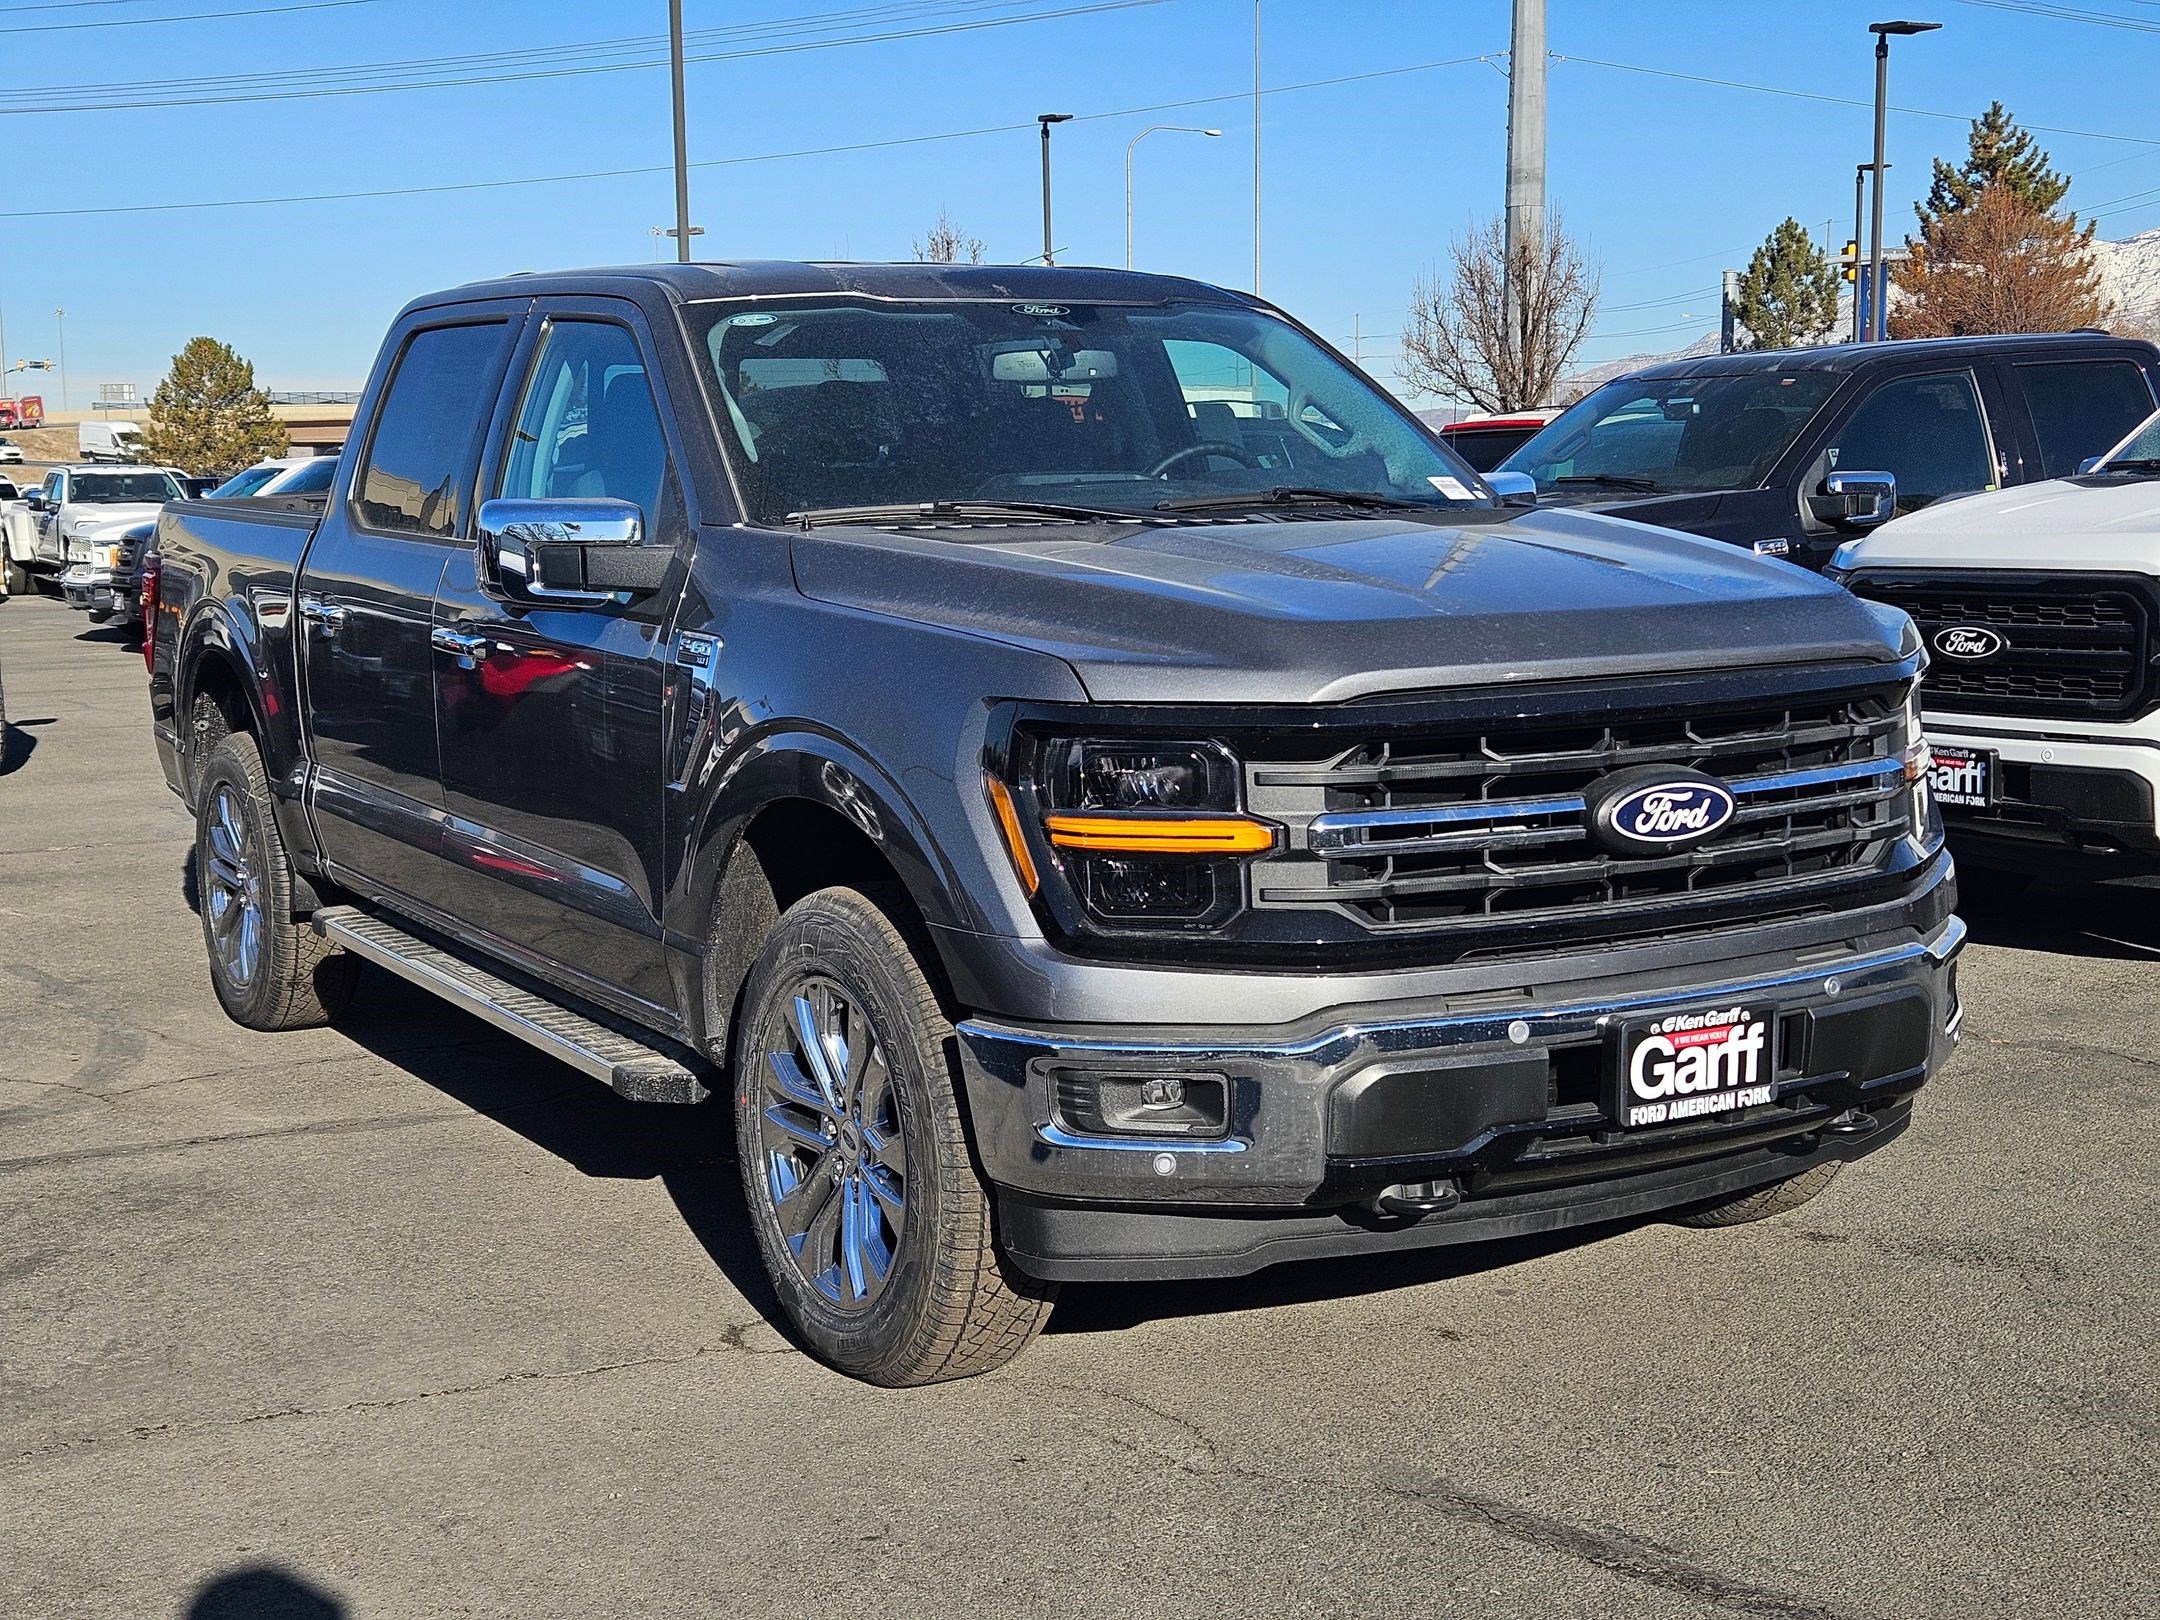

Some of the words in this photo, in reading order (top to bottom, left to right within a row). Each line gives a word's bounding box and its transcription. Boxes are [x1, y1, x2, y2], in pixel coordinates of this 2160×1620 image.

[1024, 304, 1060, 314] Ford
[1945, 631, 1987, 653] Ford
[1934, 747, 1949, 756] Ken
[1635, 791, 1711, 833] Ford
[1965, 796, 1985, 807] FORK
[1675, 1015, 1704, 1032] Ken
[1705, 1007, 1742, 1027] Garff
[1630, 1022, 1764, 1100] Garff
[1630, 1105, 1666, 1126] FORD
[1668, 1091, 1735, 1120] AMERICAN
[1738, 1086, 1772, 1108] FORK
